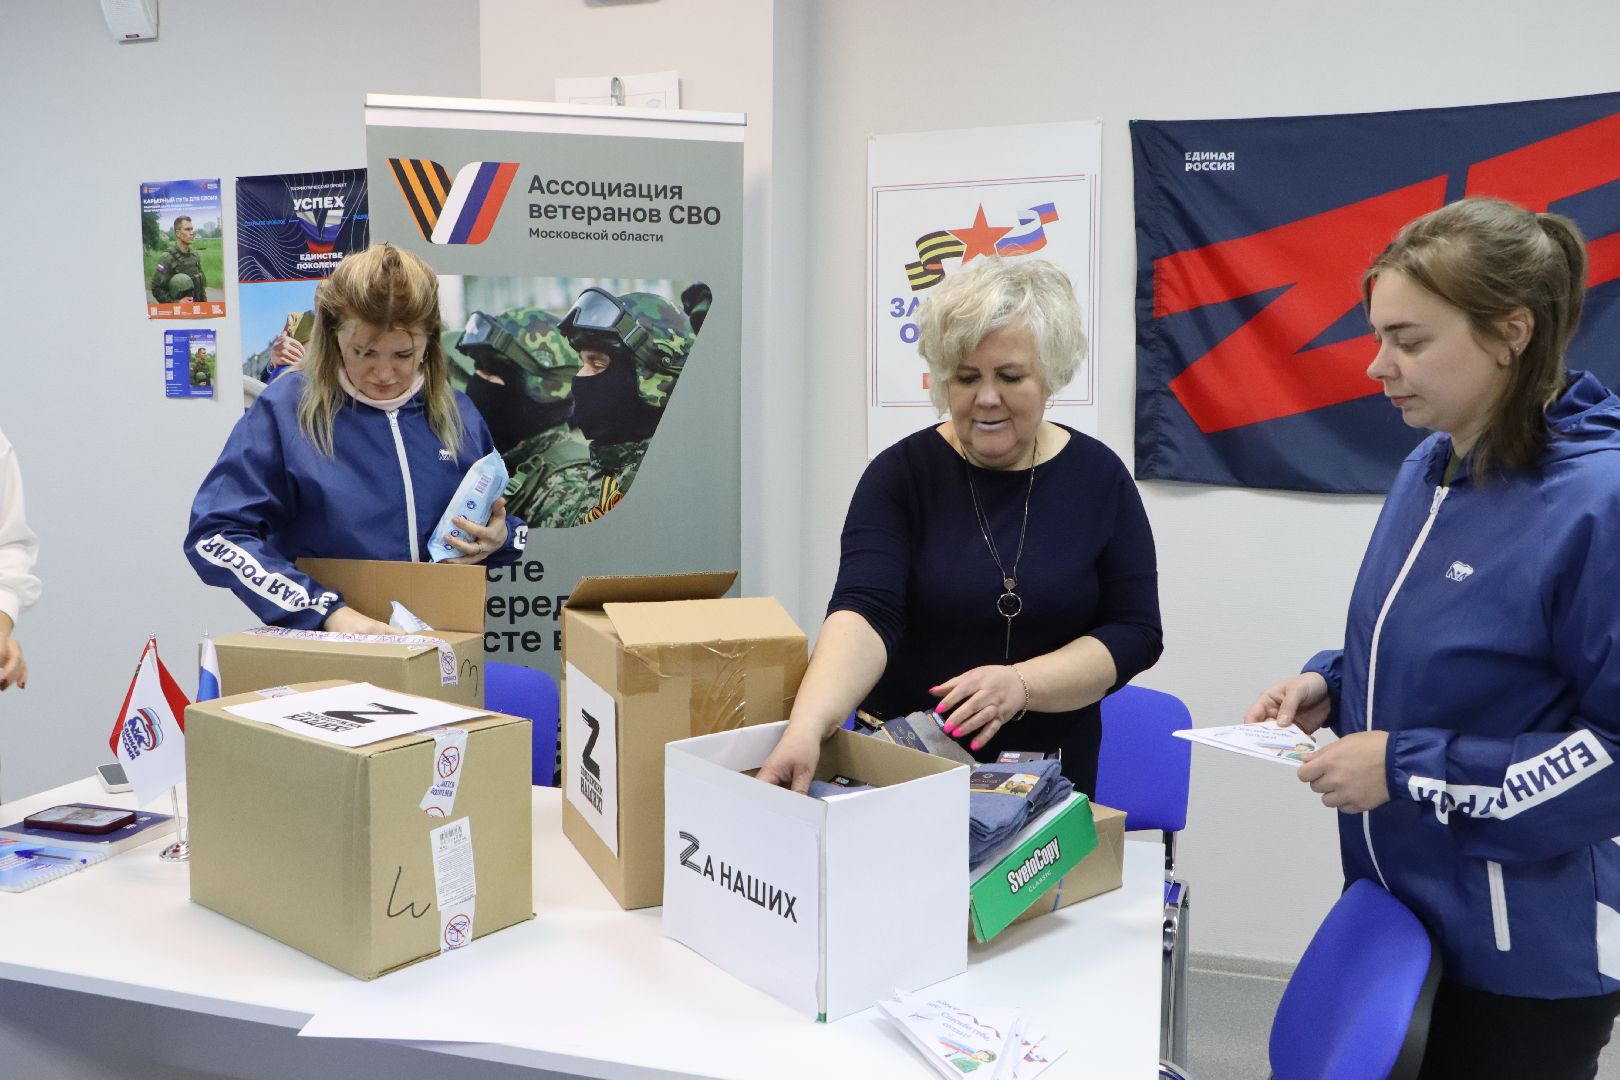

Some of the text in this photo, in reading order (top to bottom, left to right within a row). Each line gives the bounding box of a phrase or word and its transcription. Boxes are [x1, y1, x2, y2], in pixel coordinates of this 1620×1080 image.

[1185, 151, 1235, 162] ЕДИНАЯ
[1185, 162, 1235, 172] РОССИЯ
[528, 174, 683, 201] Ассоциация
[292, 195, 345, 211] УСПЕХ
[528, 202, 721, 226] ветеранов СВО
[529, 227, 664, 243] Московской области
[300, 252, 343, 261] ЕДИНСТВЕ
[201, 538, 268, 587] РОССИЯ
[486, 559, 545, 583] сте
[483, 630, 542, 653] сте
[1007, 836, 1061, 894] SvetoCopy
[720, 861, 798, 924] НАШИХ
[1028, 870, 1052, 893] CLASSIC
